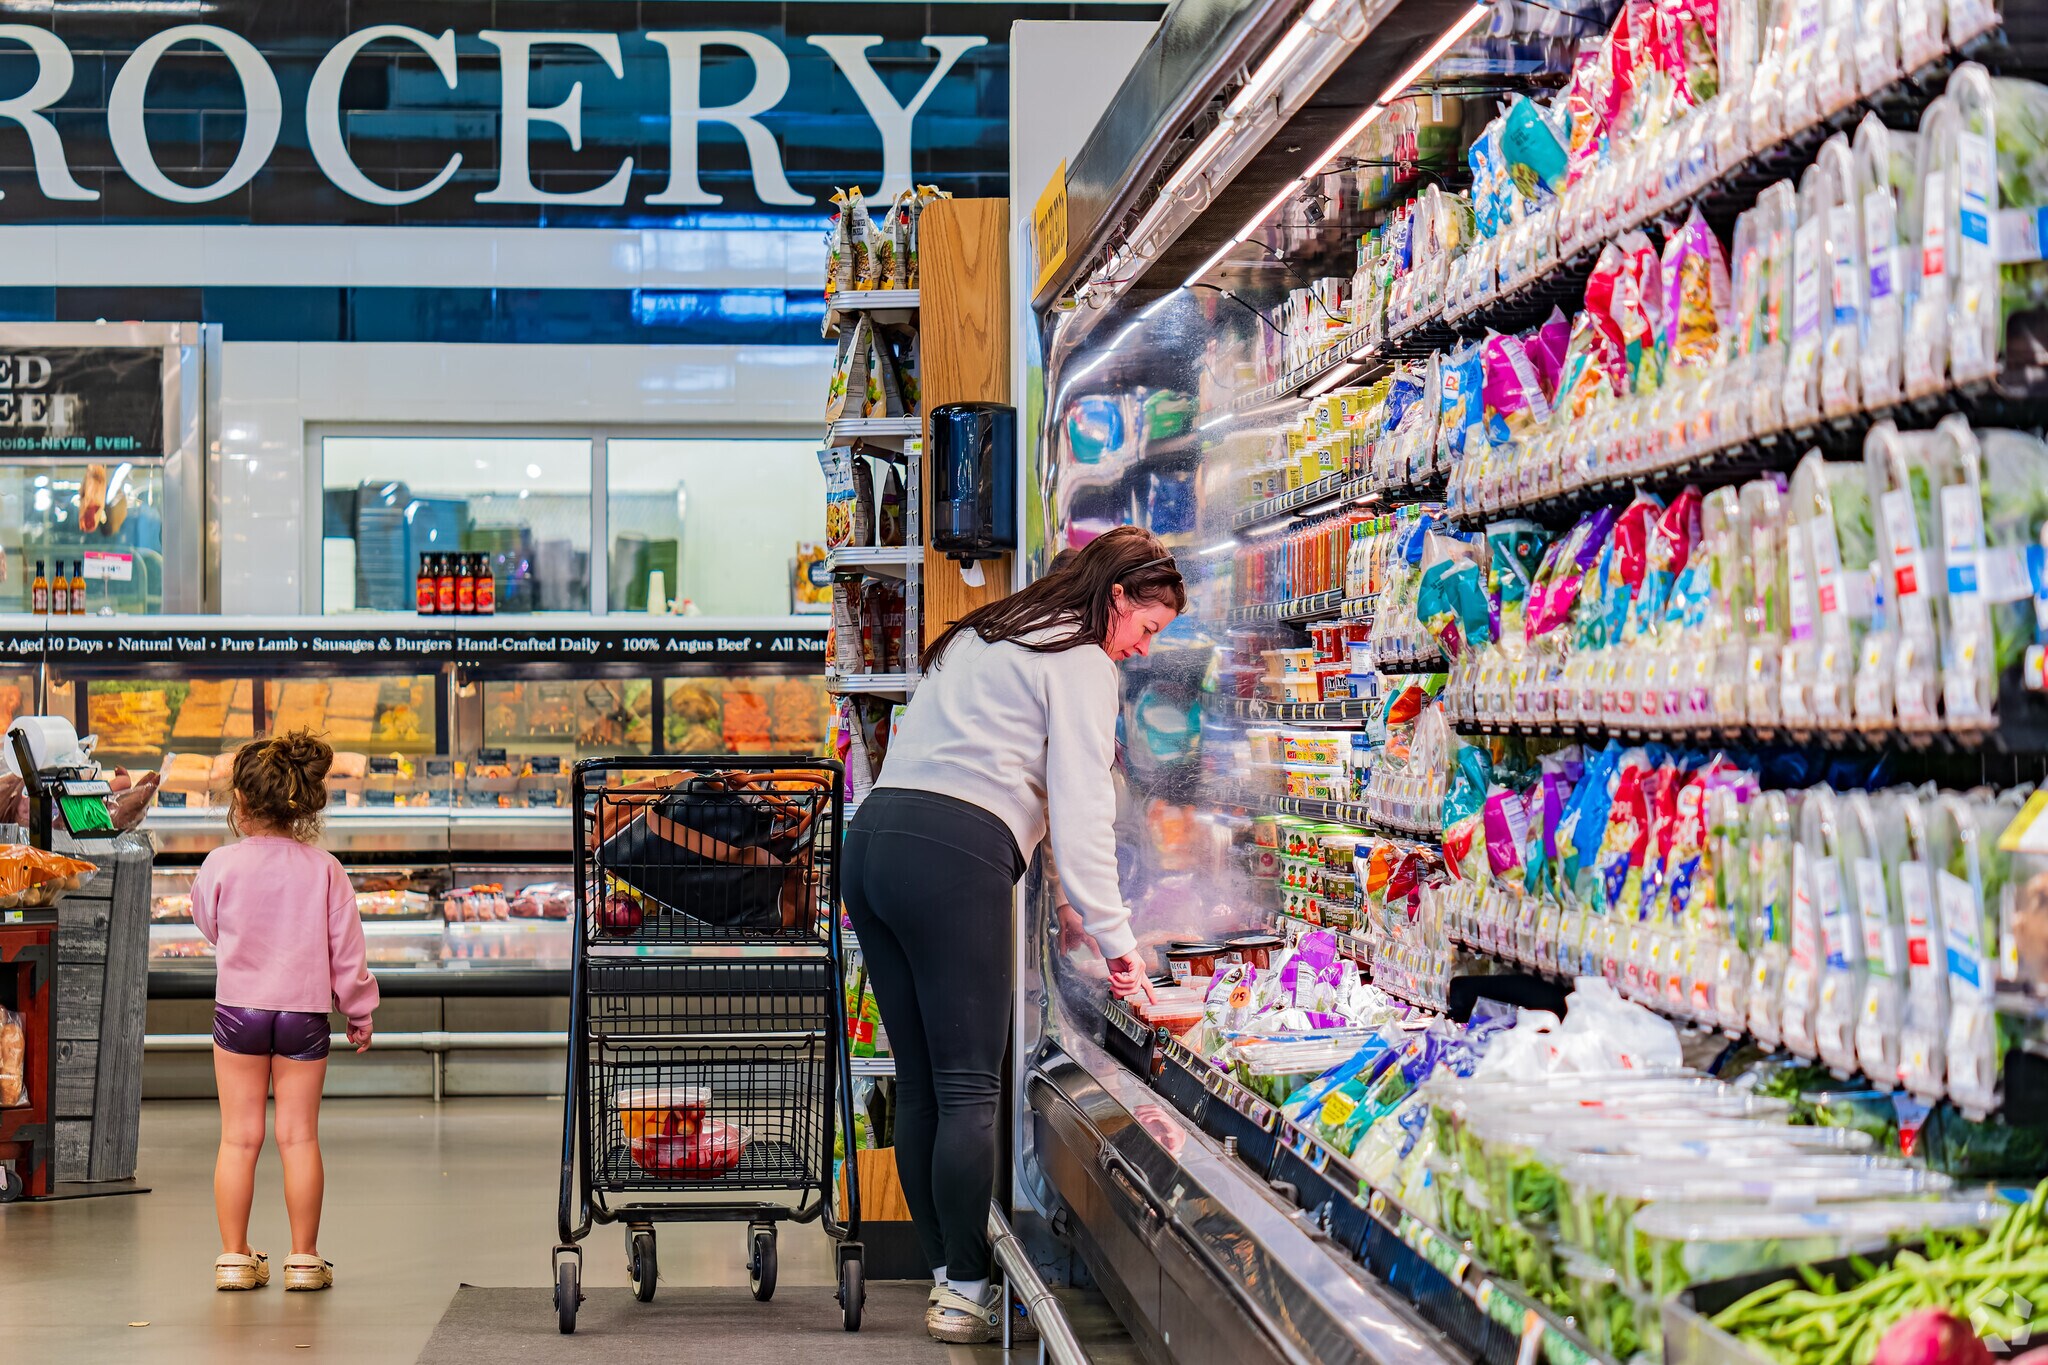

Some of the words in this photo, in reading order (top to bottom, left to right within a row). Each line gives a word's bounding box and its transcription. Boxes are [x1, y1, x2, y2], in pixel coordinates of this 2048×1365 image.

[7, 637, 44, 655] Aged
[47, 637, 65, 652] 10
[67, 637, 104, 654] Days
[118, 636, 173, 652] Natural
[176, 636, 207, 652] Veal
[221, 637, 255, 652] Pure
[257, 636, 299, 652] Lamb
[312, 637, 375, 654] Sausages
[377, 637, 392, 651] &
[395, 637, 453, 654] Burgers
[457, 637, 556, 652] Hand-Crafted
[560, 637, 601, 655] Daily
[623, 637, 660, 652] 100%
[665, 637, 714, 654] Angus
[717, 637, 752, 652] Beef
[770, 637, 794, 652] All
